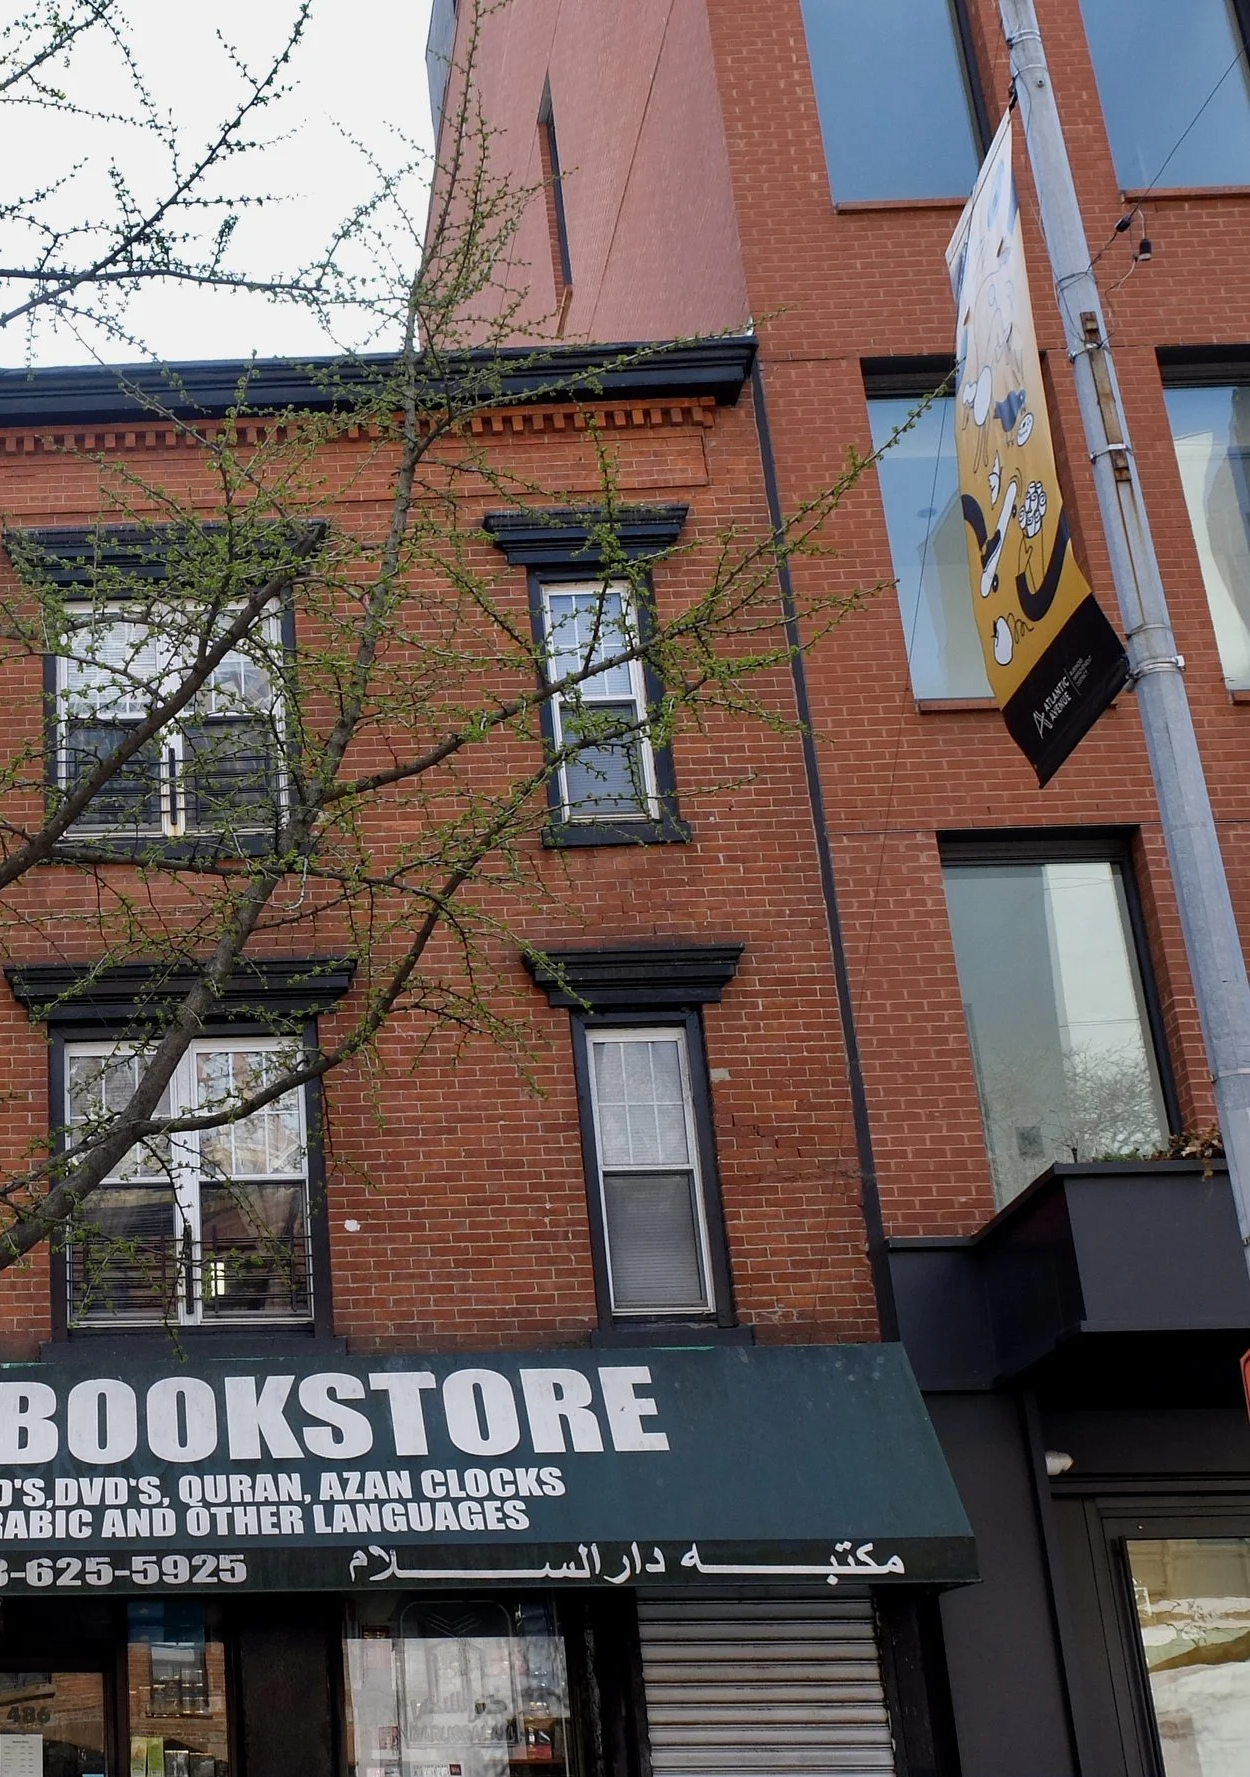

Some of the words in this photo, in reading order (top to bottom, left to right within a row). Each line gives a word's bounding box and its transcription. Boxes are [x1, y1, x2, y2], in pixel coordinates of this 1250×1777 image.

[1044, 676, 1070, 712] ATLANTIC
[1049, 691, 1072, 722] AVENUE
[178, 1473, 312, 1507] QURAN,
[320, 1470, 410, 1500] AZAN
[421, 1467, 566, 1499] CLOCKS
[101, 1507, 177, 1538] AND
[186, 1504, 304, 1537] OTHER
[313, 1500, 530, 1534] LANGUAGES
[6, 1706, 50, 1724] 486
